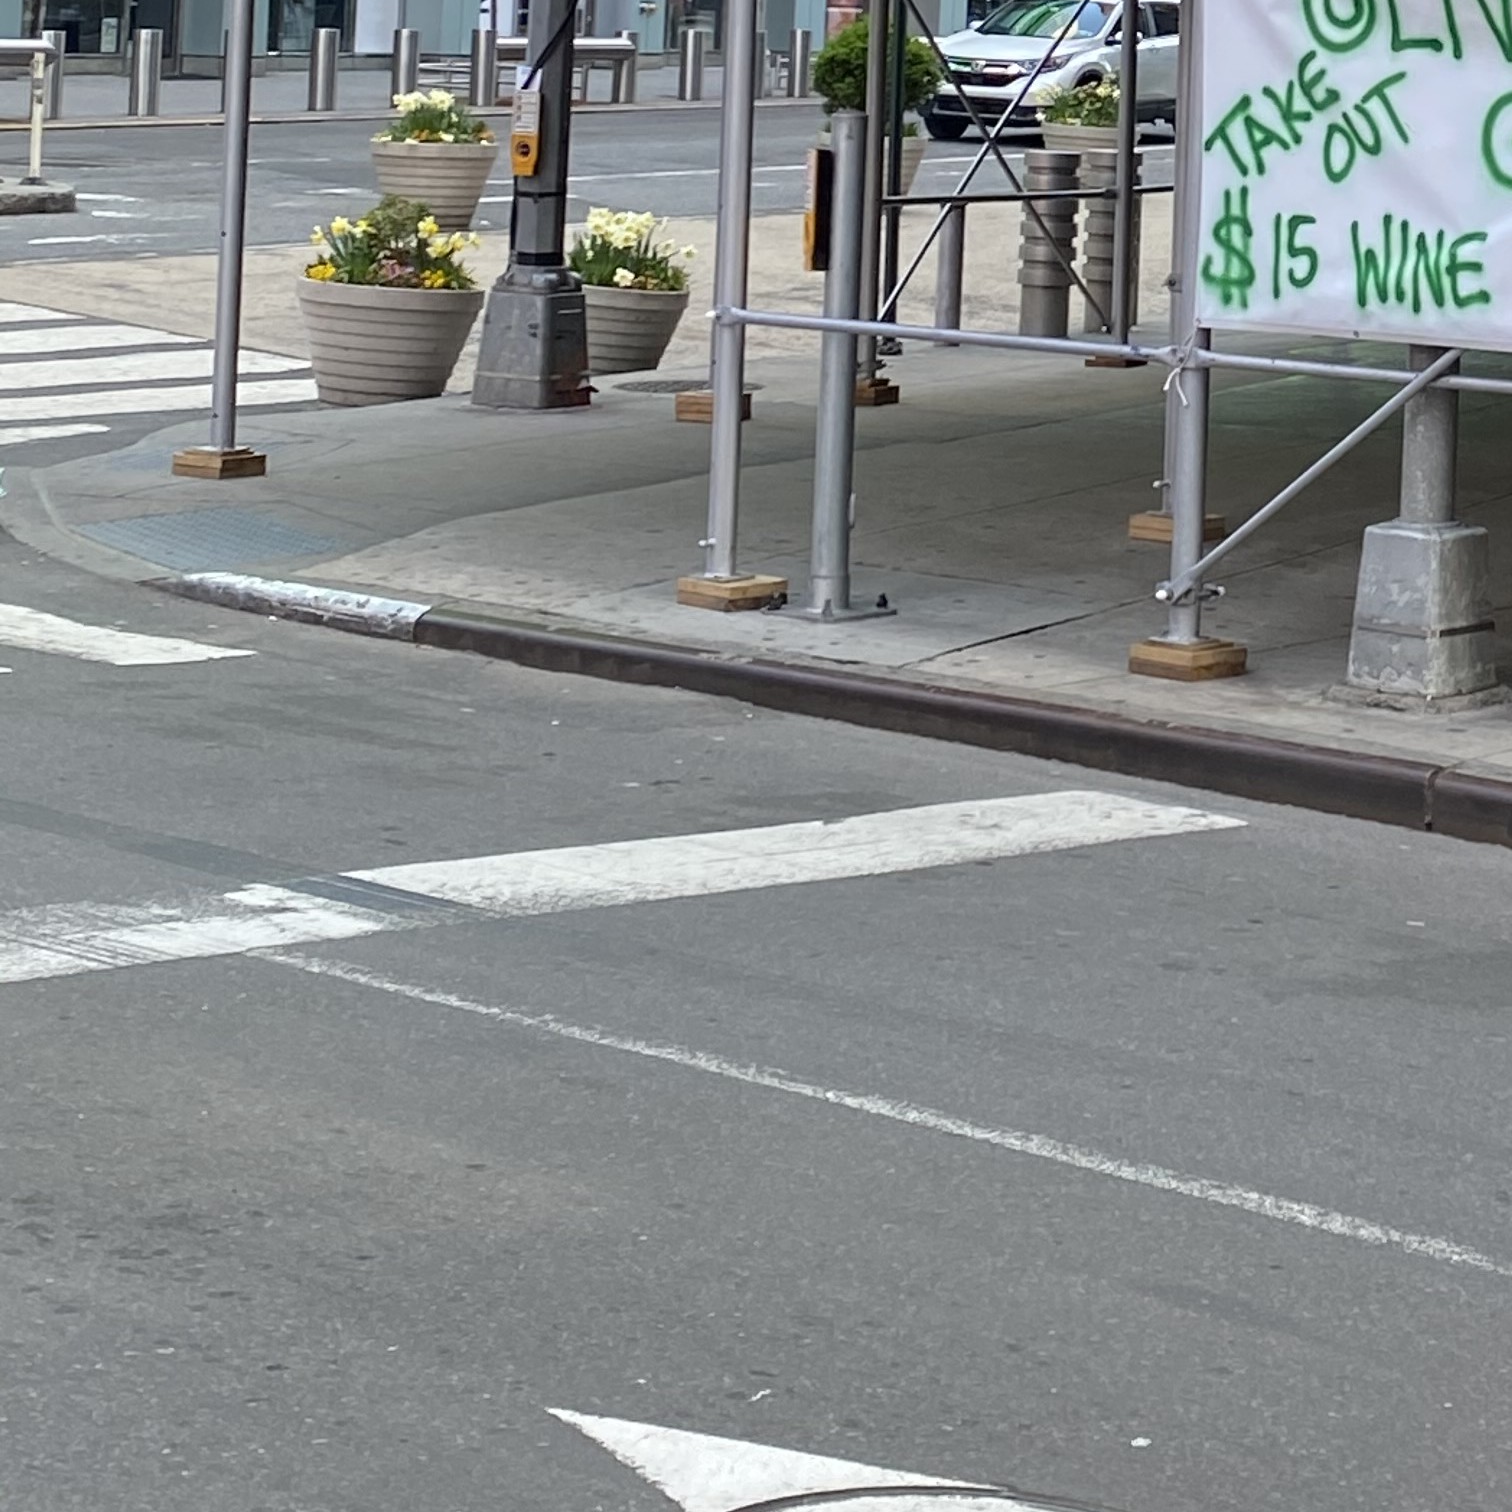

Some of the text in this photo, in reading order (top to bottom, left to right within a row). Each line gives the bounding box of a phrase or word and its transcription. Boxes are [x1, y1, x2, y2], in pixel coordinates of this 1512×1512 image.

[1204, 50, 1339, 177] TAKE
[1322, 72, 1409, 183] OUT
[1350, 214, 1491, 314] WINE
